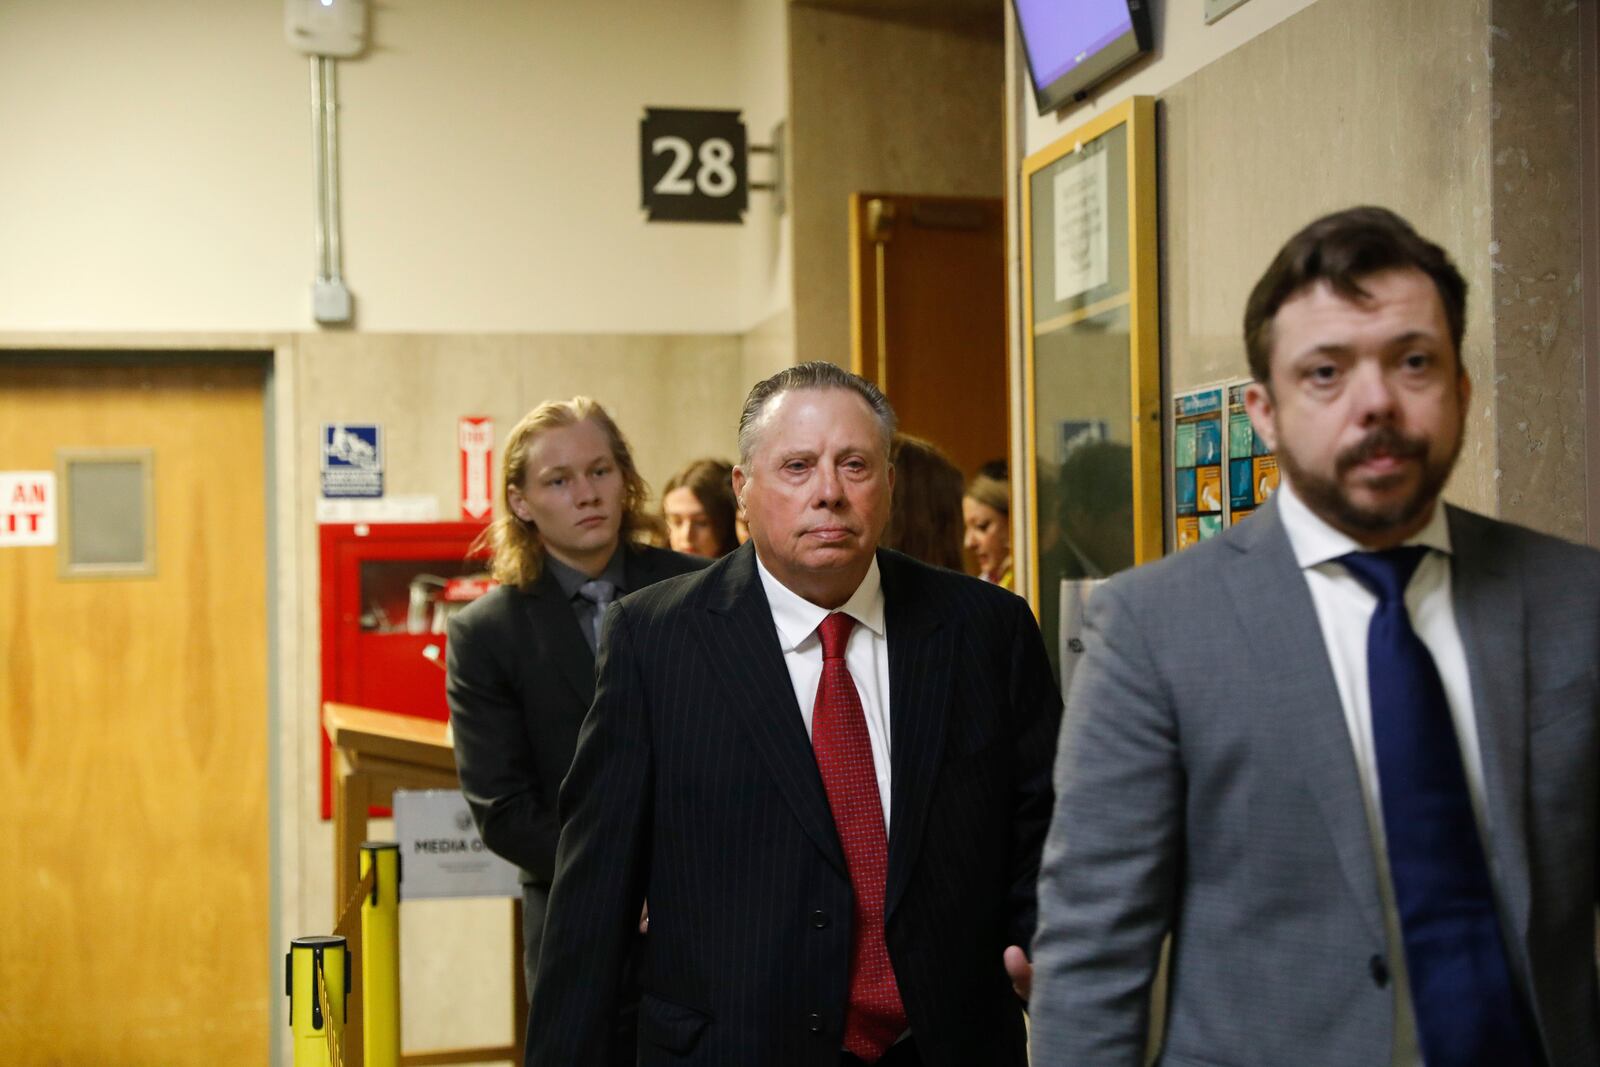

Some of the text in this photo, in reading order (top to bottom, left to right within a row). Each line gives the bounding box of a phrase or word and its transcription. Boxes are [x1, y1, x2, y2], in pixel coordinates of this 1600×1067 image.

[651, 136, 737, 198] 28
[13, 483, 46, 503] AN
[0, 512, 44, 533] IT
[414, 838, 467, 854] MEDIA
